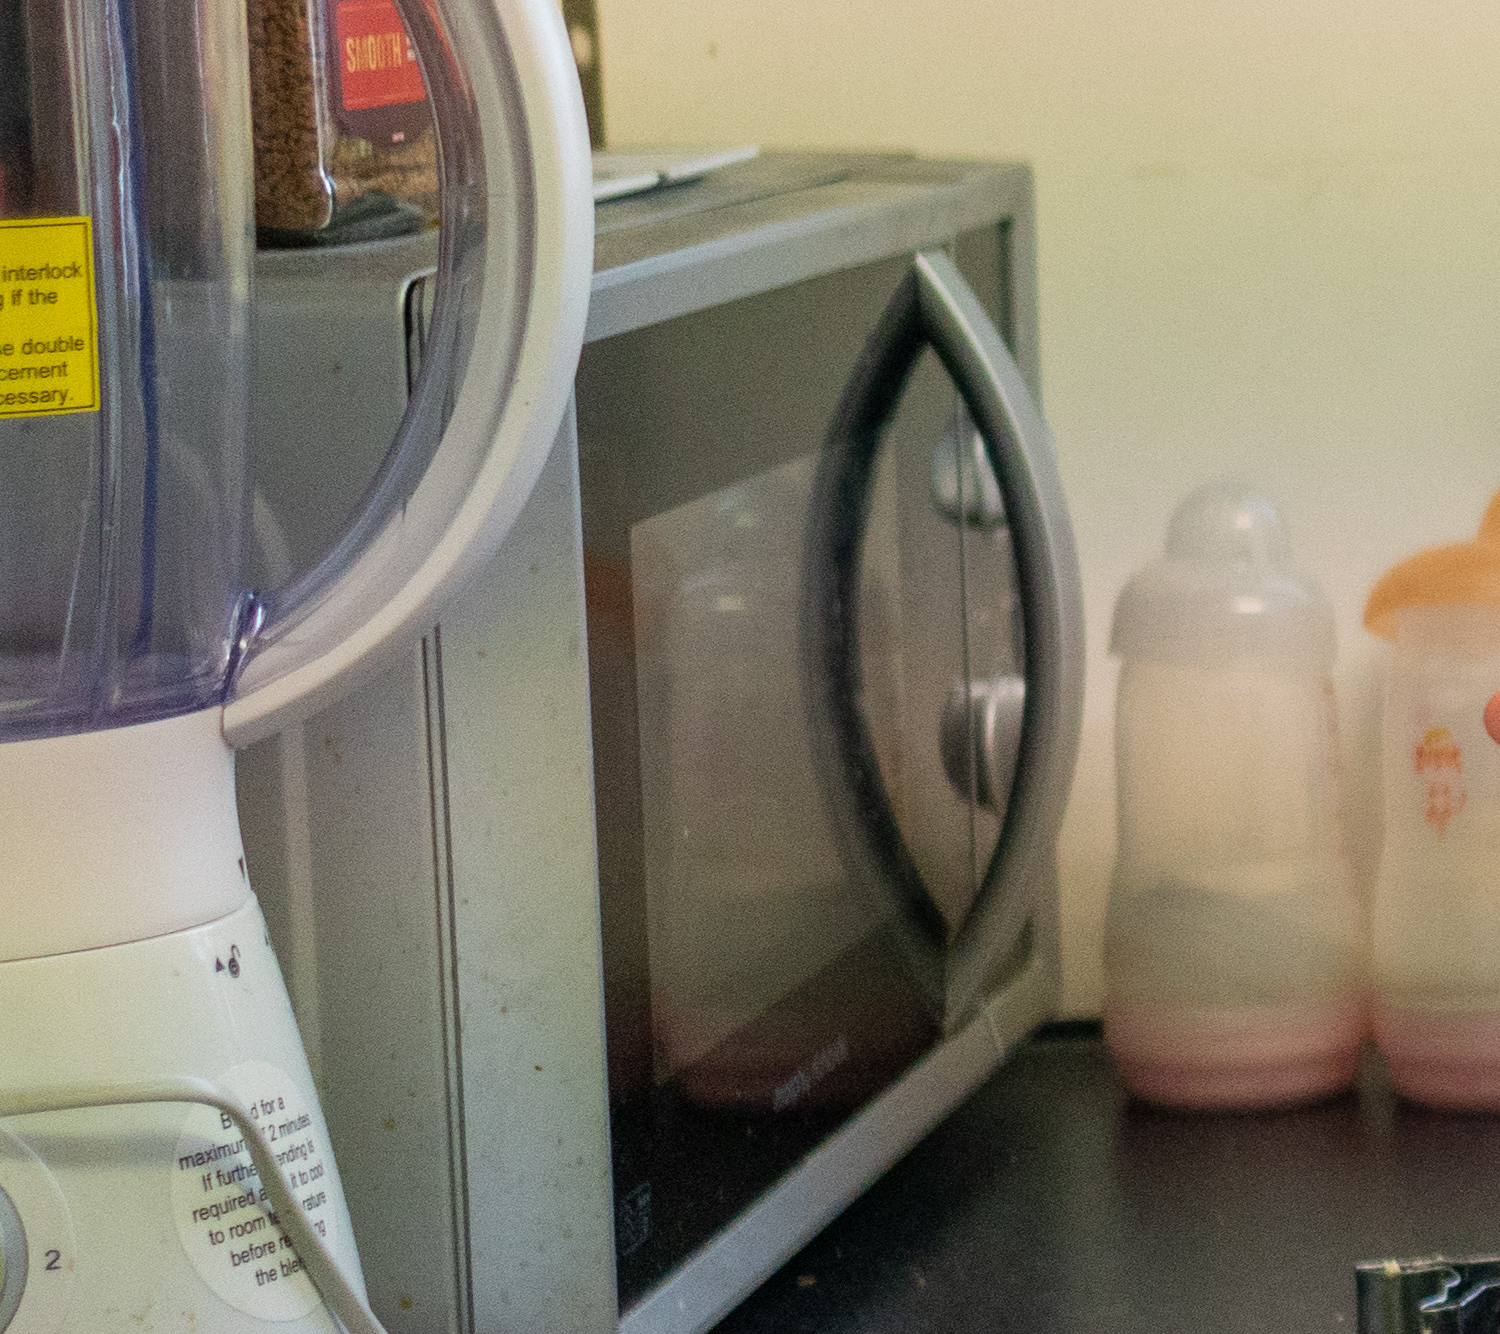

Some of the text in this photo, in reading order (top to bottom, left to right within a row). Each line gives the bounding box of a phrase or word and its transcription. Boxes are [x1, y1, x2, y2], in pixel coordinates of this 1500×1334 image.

[345, 31, 402, 73] SMOOTH
[2, 262, 83, 282] interlock
[28, 288, 58, 305] the
[21, 336, 85, 355] double
[260, 1098, 276, 1115] for
[268, 1124, 277, 1142] 2
[279, 1113, 312, 1139] minutes
[202, 1171, 213, 1193] If
[192, 1187, 256, 1223] required
[208, 1229, 225, 1246] to
[229, 1215, 267, 1240] room
[45, 1249, 62, 1271] 2
[230, 1240, 276, 1267] before
[255, 1268, 278, 1287] the
